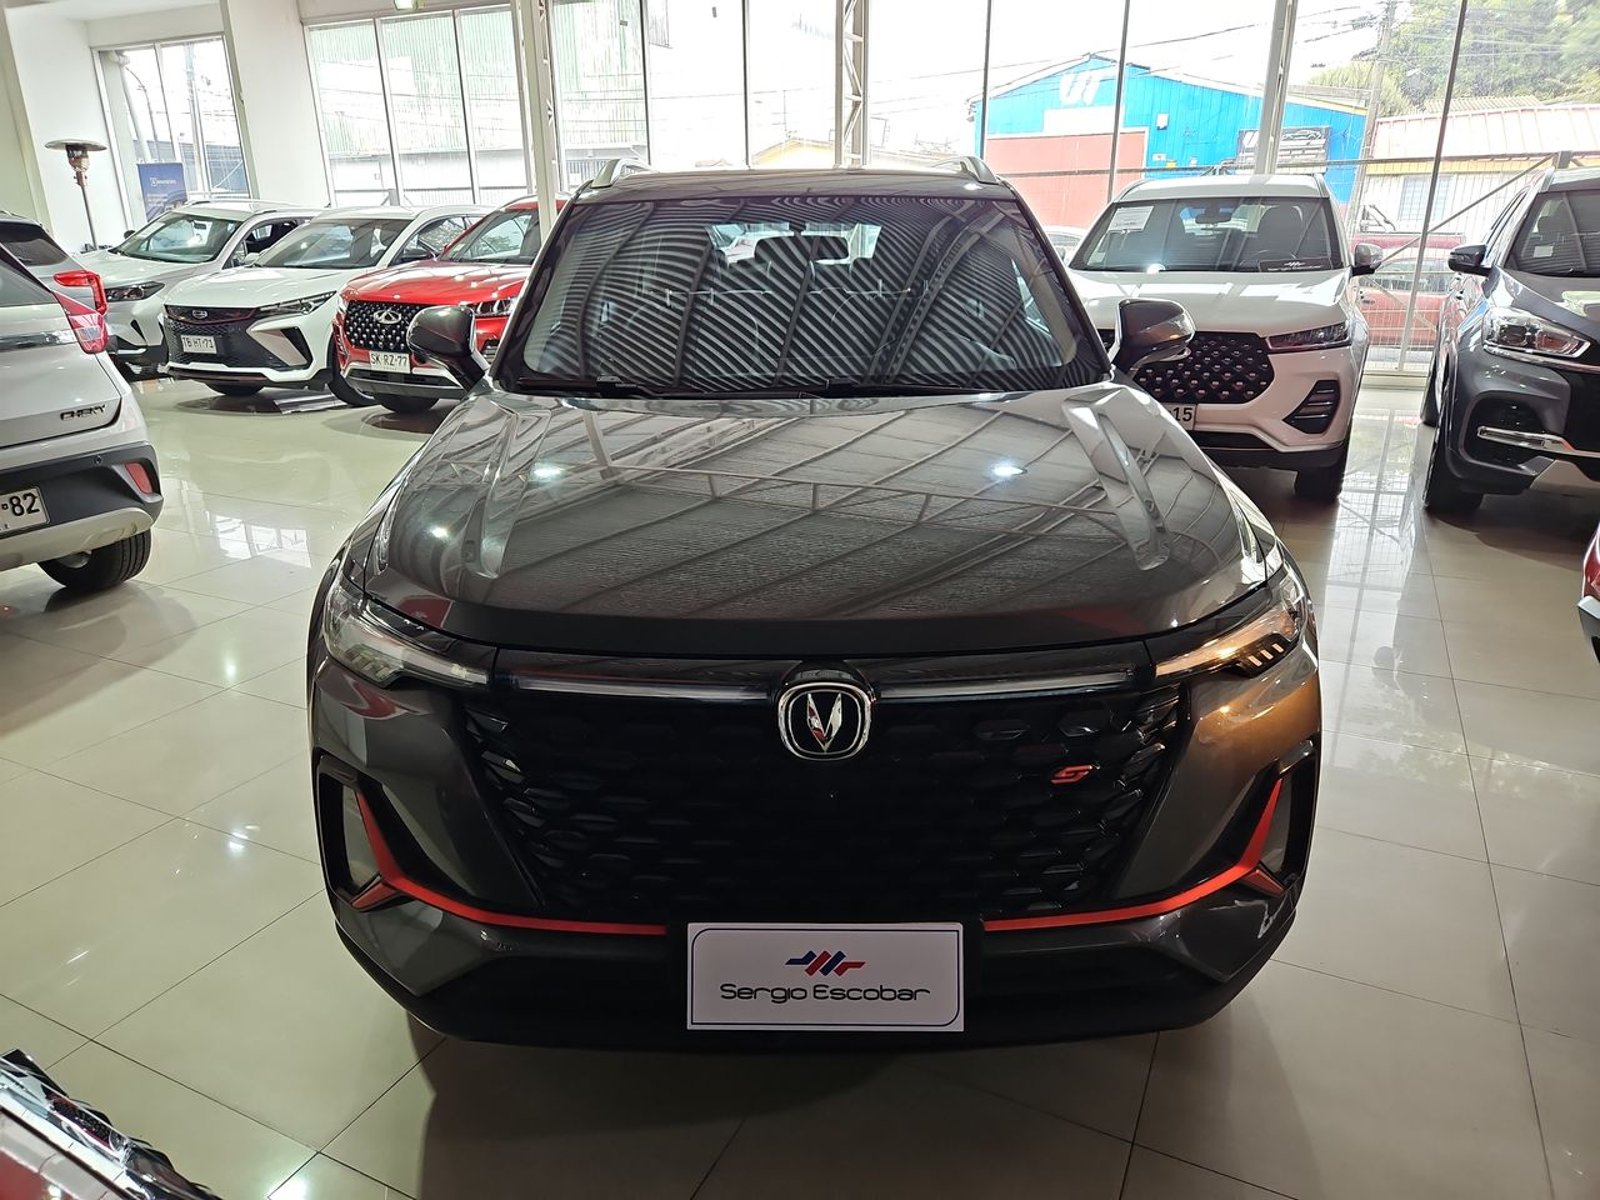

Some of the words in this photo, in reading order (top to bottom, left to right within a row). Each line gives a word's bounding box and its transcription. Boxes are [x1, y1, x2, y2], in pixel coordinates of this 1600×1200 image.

[60, 404, 106, 420] CHERY
[719, 983, 808, 1004] Sergio
[813, 984, 931, 1001] Escobar
